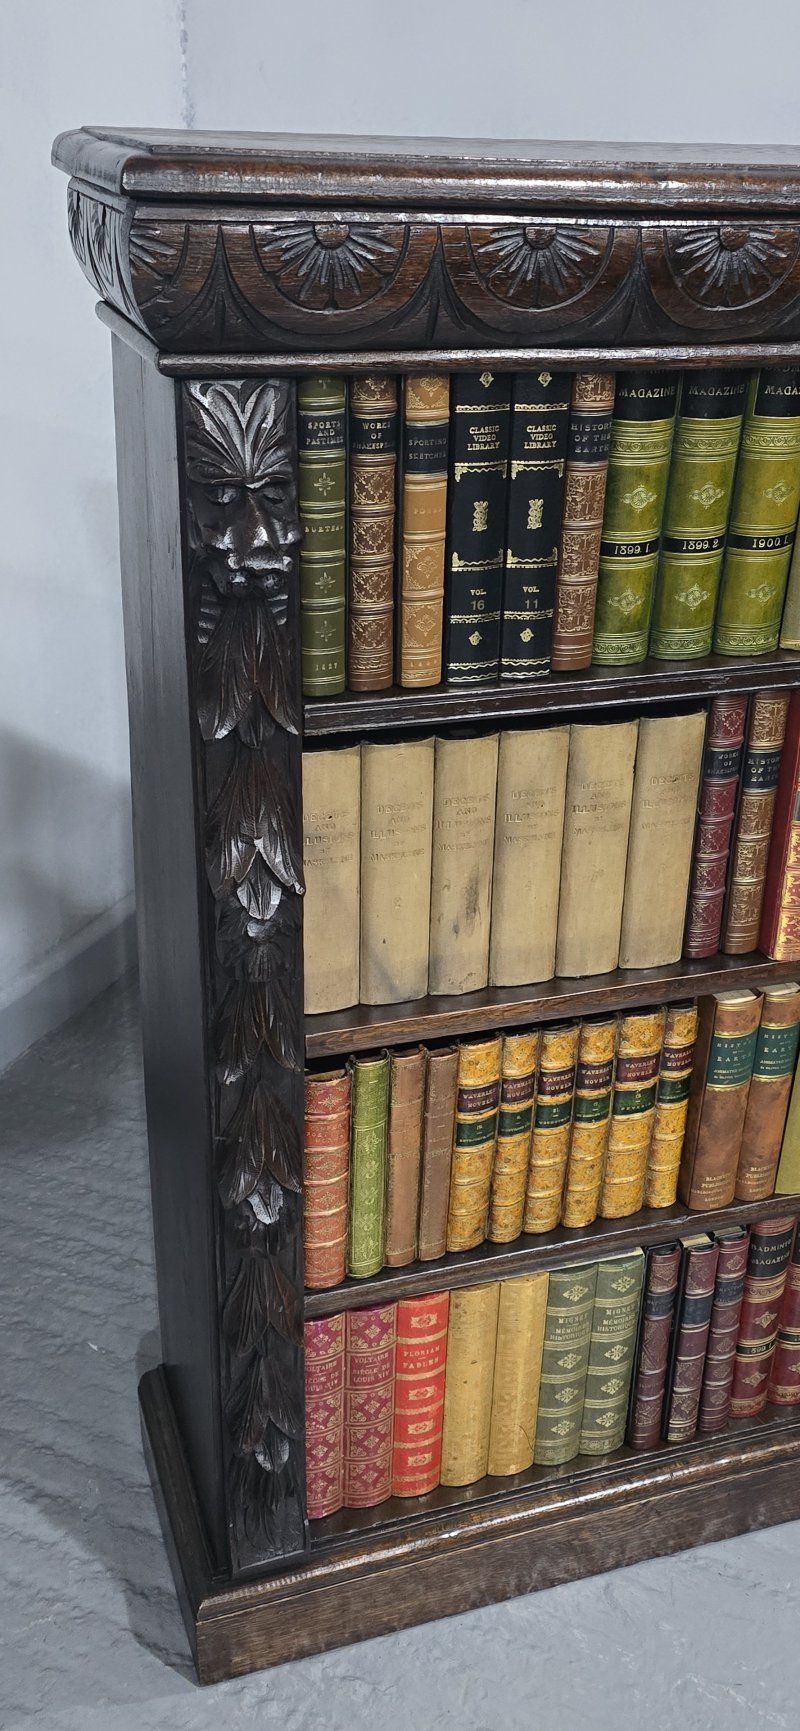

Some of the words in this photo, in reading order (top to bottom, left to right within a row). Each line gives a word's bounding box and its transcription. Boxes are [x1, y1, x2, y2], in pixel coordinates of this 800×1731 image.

[618, 386, 676, 398] MAGAZINE
[689, 384, 744, 396] MAGAZINE
[764, 386, 800, 396] MAGA
[308, 421, 341, 430] SPORTS
[469, 426, 500, 434] CLASSIC
[526, 424, 556, 432] CLASSIC
[318, 429, 336, 437] AND
[370, 432, 382, 440] OF
[473, 434, 496, 442] VIDEO
[530, 432, 554, 440] VIDEO
[306, 436, 344, 446] PASTIMES
[574, 434, 588, 443] OF
[467, 441, 500, 450] LIBRARY
[524, 440, 558, 449] LIBRARY
[712, 538, 720, 548] 2
[471, 600, 485, 610] 16
[525, 599, 538, 608] 11
[625, 1058, 657, 1068] WAVERLEY
[666, 1058, 692, 1067] NOVELS
[582, 1064, 612, 1075] WAVERLEY
[627, 1070, 653, 1078] NOVELS
[542, 1072, 574, 1082] WAVERLEY
[584, 1076, 610, 1084] NOVELS
[502, 1078, 534, 1090] WAVERLEY
[546, 1082, 572, 1091] NOVELS
[462, 1088, 496, 1099] WAVERLEY
[506, 1088, 532, 1098] NOVELS
[467, 1098, 494, 1108] NOVELS
[606, 1304, 636, 1316] MIGNET
[558, 1312, 588, 1324] MIGNET
[404, 1346, 440, 1357] FLORIAN
[354, 1352, 388, 1363] VOLTAIRE
[382, 1362, 391, 1370] DE
[402, 1356, 439, 1370] FABLES
[353, 1375, 375, 1384] LOUIS
[378, 1370, 390, 1380] XIV
